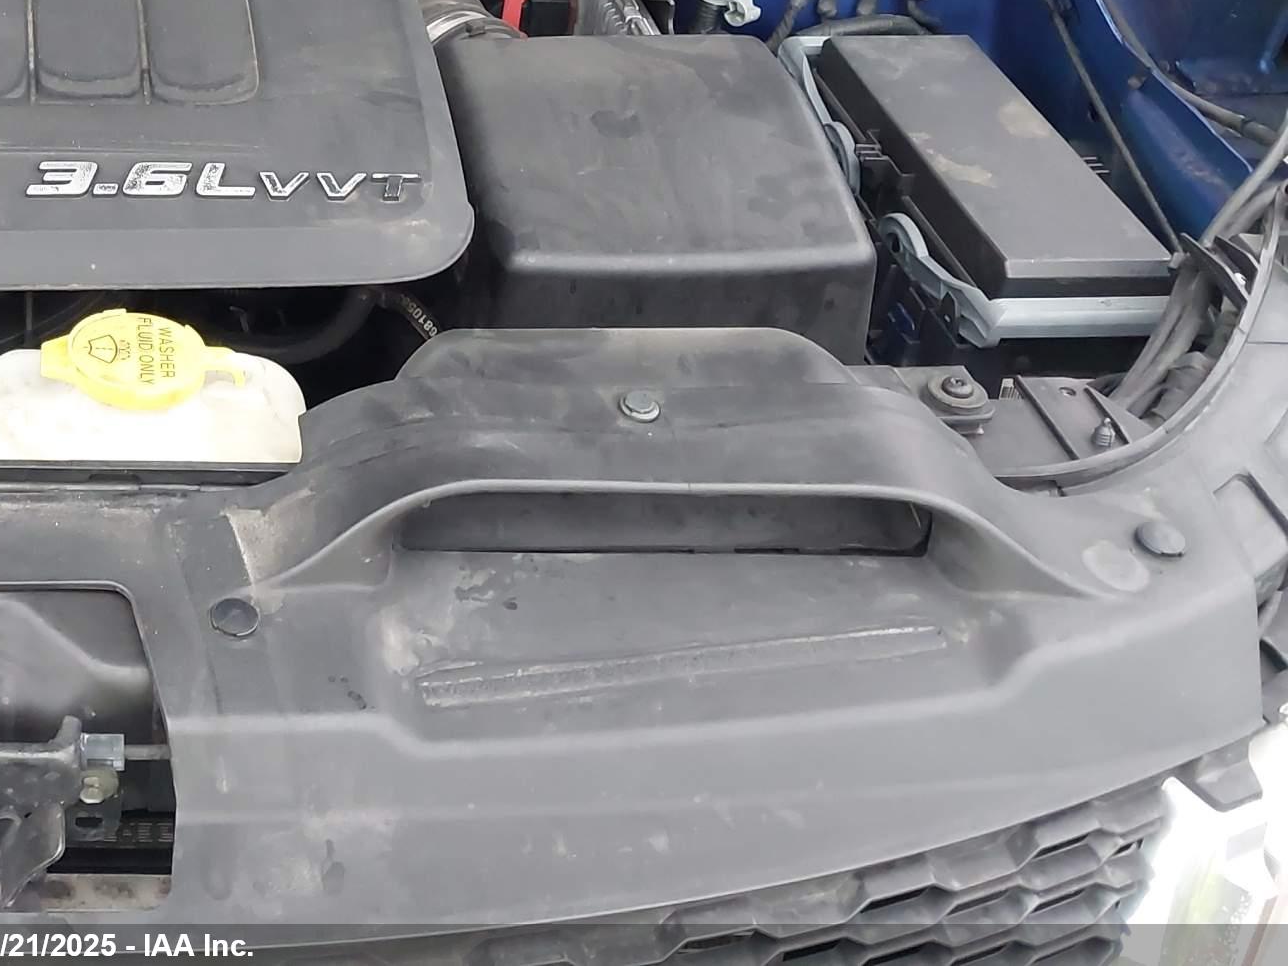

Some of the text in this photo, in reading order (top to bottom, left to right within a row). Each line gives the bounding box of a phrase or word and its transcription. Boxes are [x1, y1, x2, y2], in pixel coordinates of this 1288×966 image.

[25, 160, 422, 201] 3.6L VVT
[136, 317, 155, 385] FLUID ONLY
[158, 327, 176, 378] WASHER
